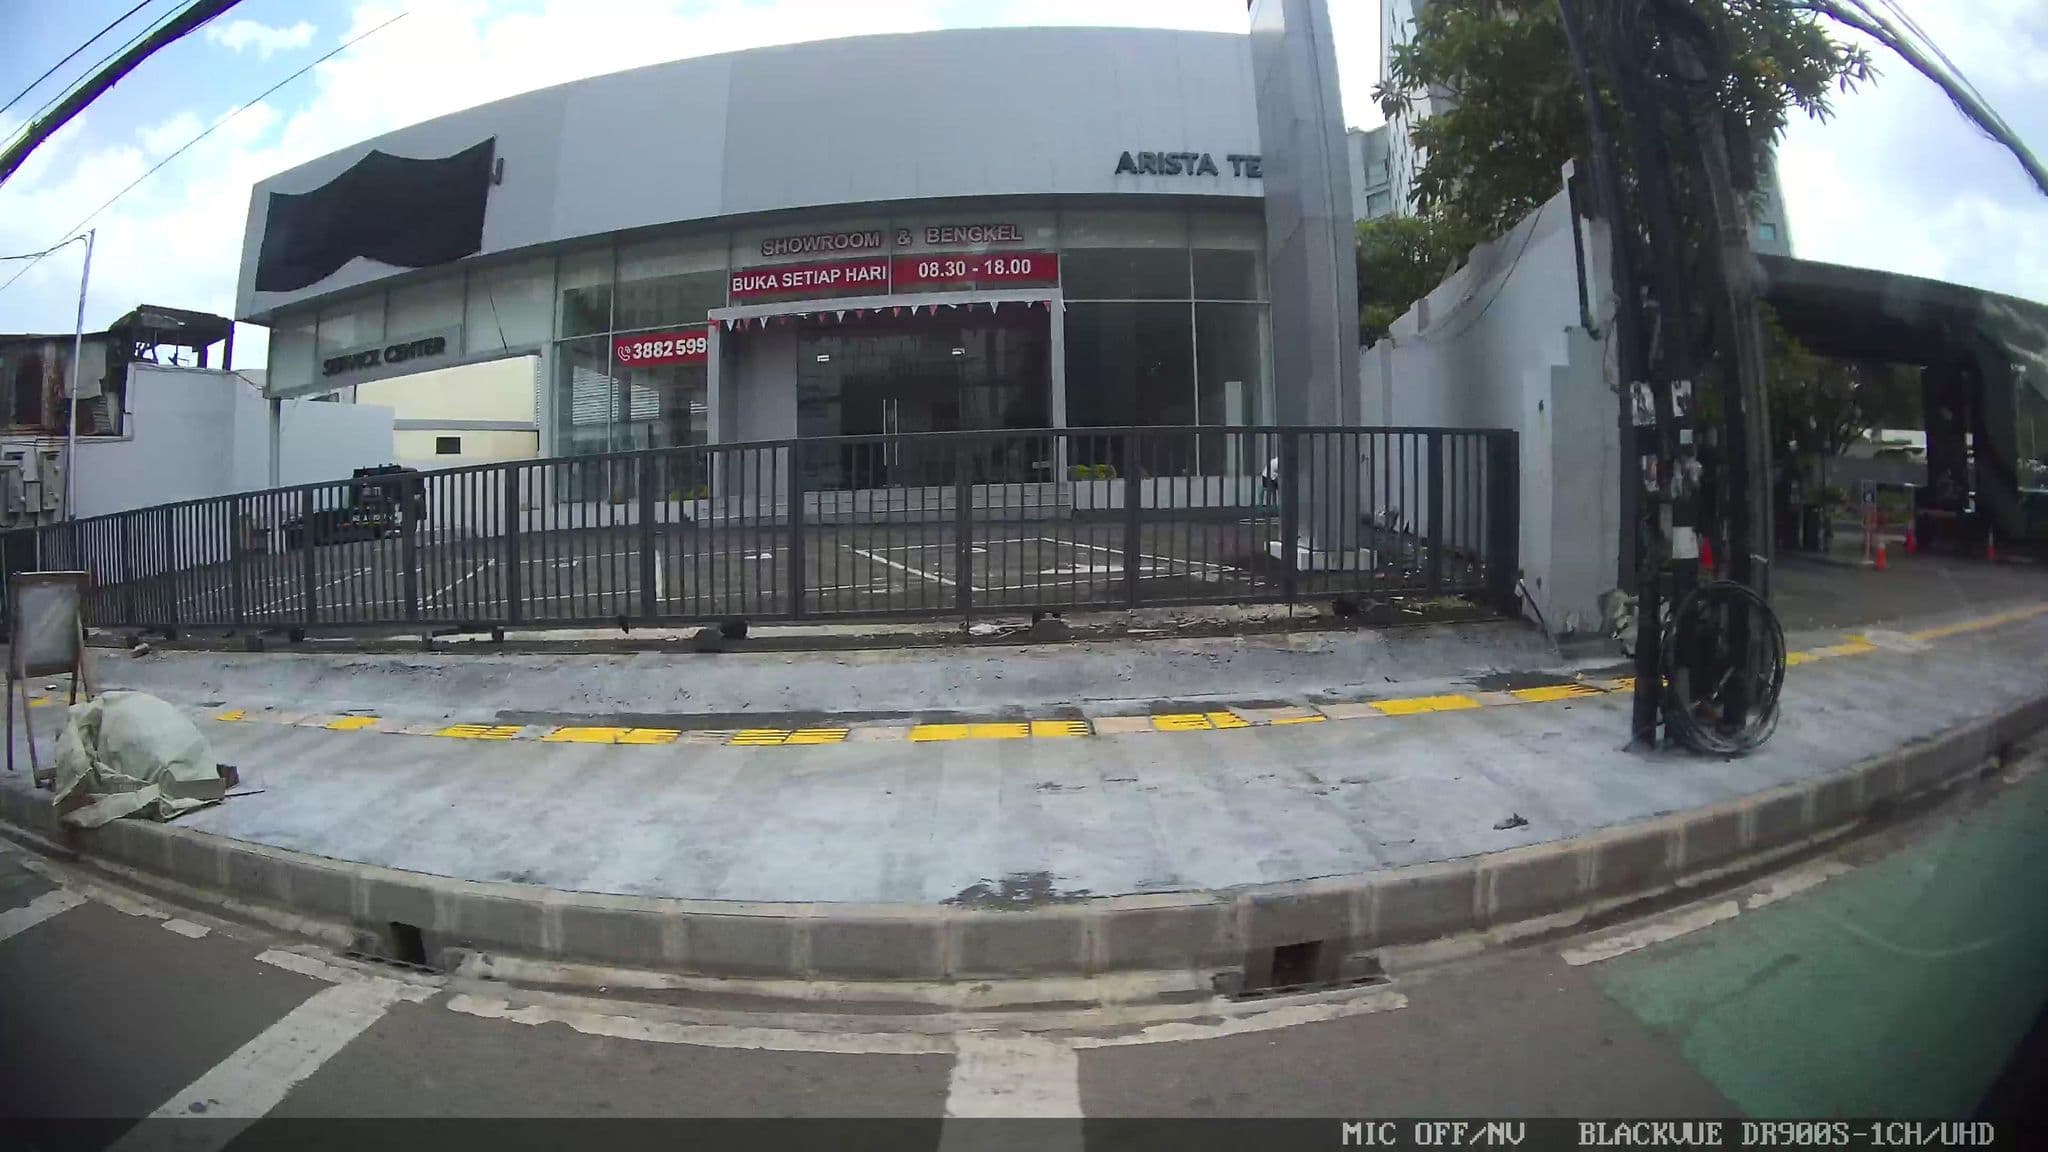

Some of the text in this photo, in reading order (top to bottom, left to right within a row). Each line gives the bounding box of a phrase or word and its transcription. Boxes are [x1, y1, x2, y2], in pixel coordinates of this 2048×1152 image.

[1115, 151, 1219, 176] ARISTA
[762, 224, 1023, 257] SHOWROOM & BENGKEL
[732, 266, 887, 292] BUKA SETIAP HARI
[918, 261, 966, 278] 08.30
[985, 259, 1031, 275] 18.00
[633, 338, 709, 359] 3882 599
